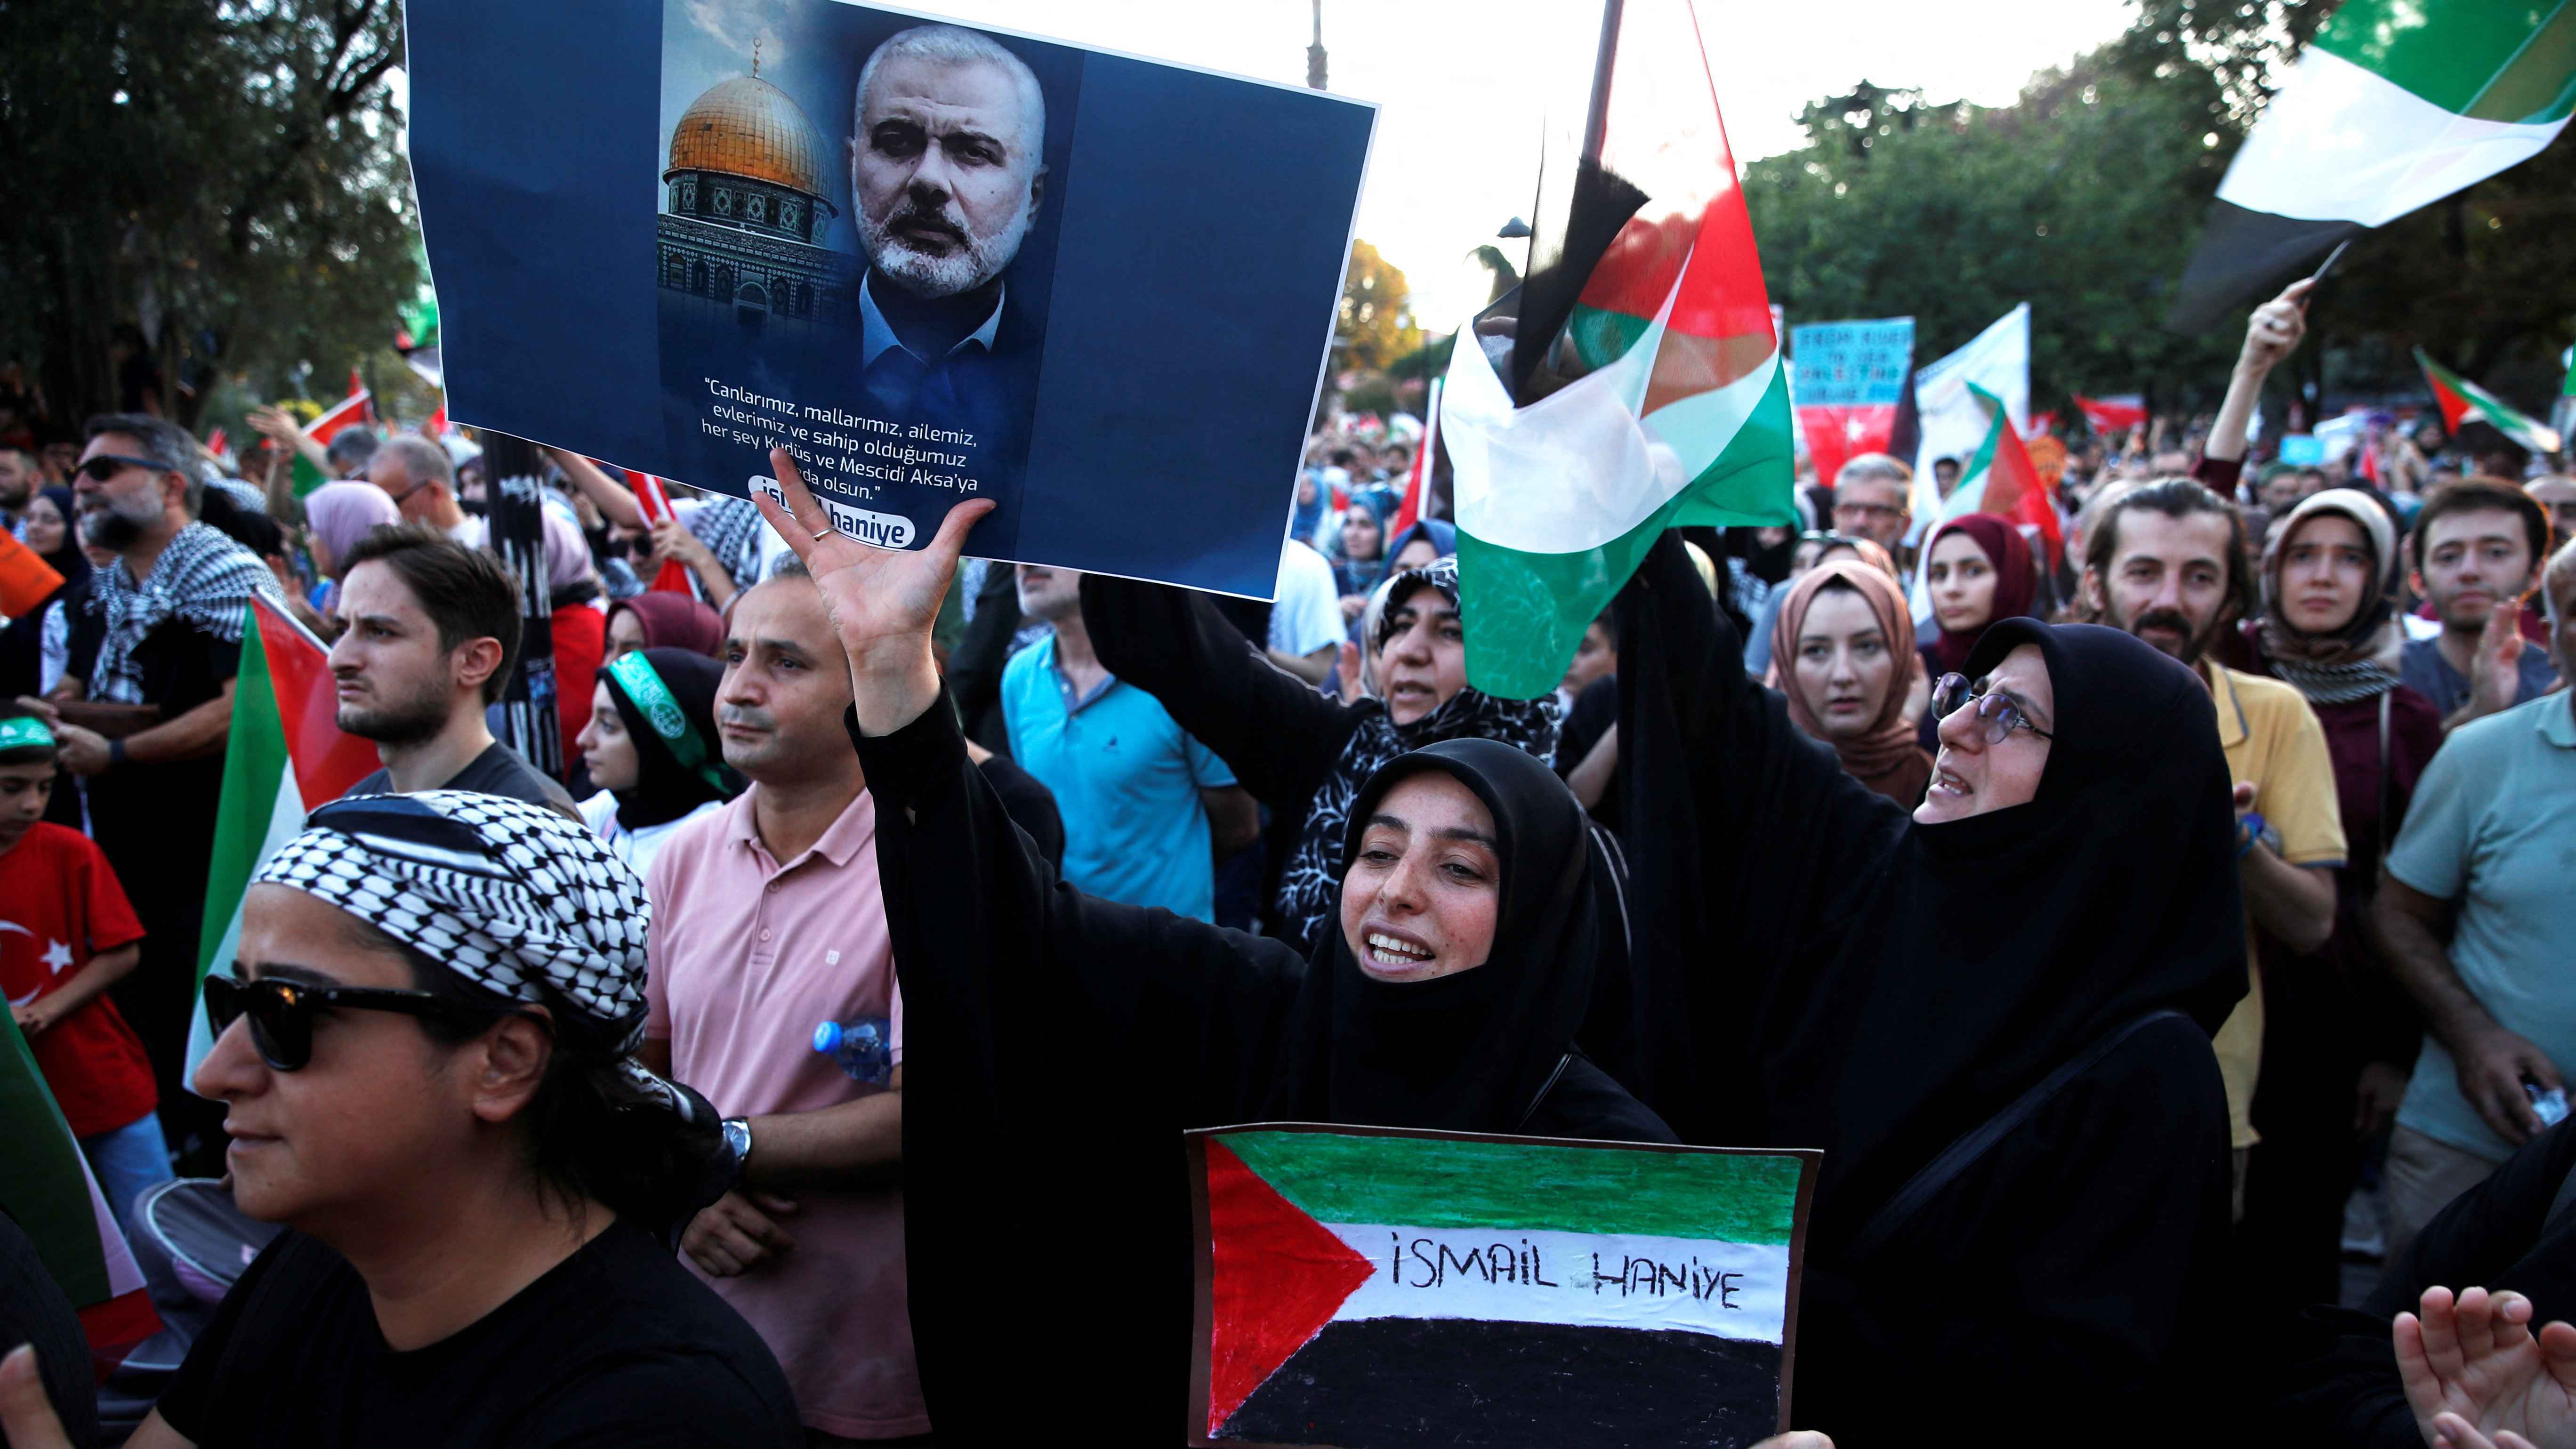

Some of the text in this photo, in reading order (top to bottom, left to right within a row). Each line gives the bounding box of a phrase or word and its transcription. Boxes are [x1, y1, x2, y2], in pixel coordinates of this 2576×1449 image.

[702, 418, 728, 437] her
[733, 430, 759, 449] şey
[815, 454, 835, 469] ve
[839, 456, 904, 482] Mescidi
[713, 405, 966, 467] evlerimiz ve sahip olduğumuz
[805, 408, 902, 438] mallarımız,
[909, 423, 977, 448] ailemiz,
[829, 503, 905, 547] haniye
[1593, 1252, 1744, 1310] HANİYE
